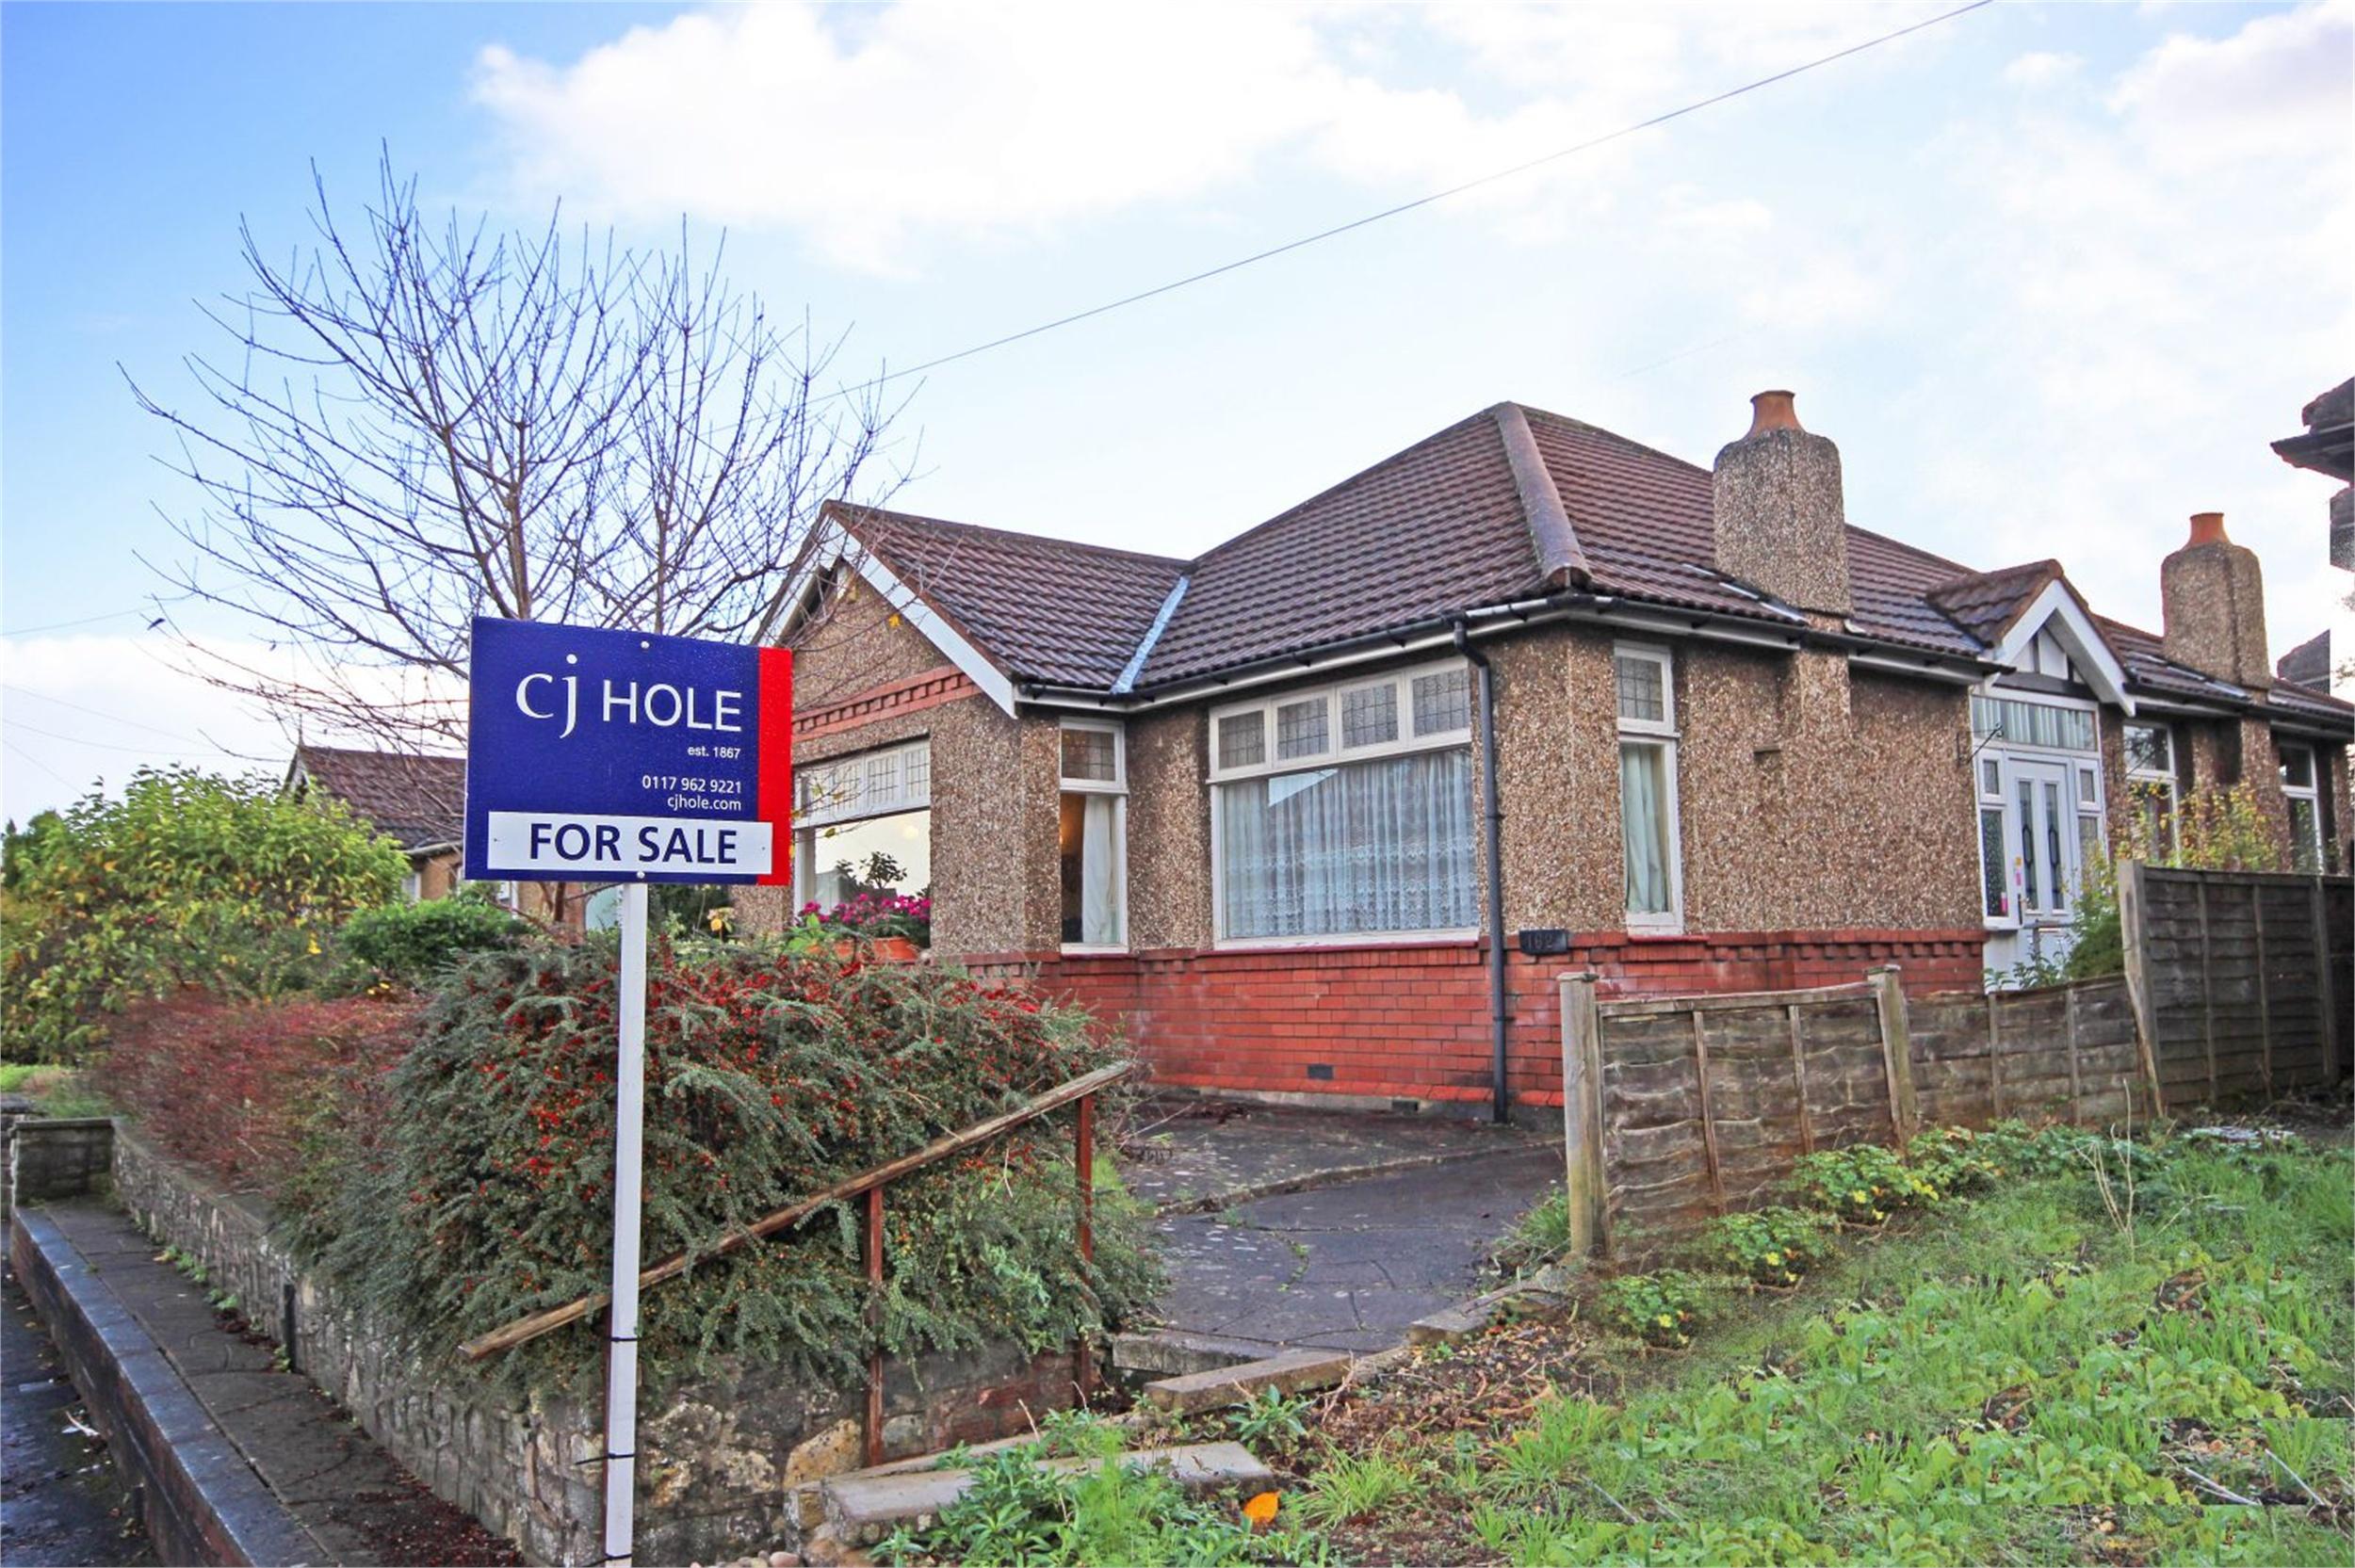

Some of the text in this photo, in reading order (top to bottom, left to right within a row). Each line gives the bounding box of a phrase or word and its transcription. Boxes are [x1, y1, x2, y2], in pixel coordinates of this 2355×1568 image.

[602, 679, 742, 733] HOLE
[687, 746, 741, 759] est. 1867
[642, 774, 742, 794] 0117 962 9221
[667, 794, 742, 812] cjhole.com
[529, 822, 738, 865] FOR SALE
